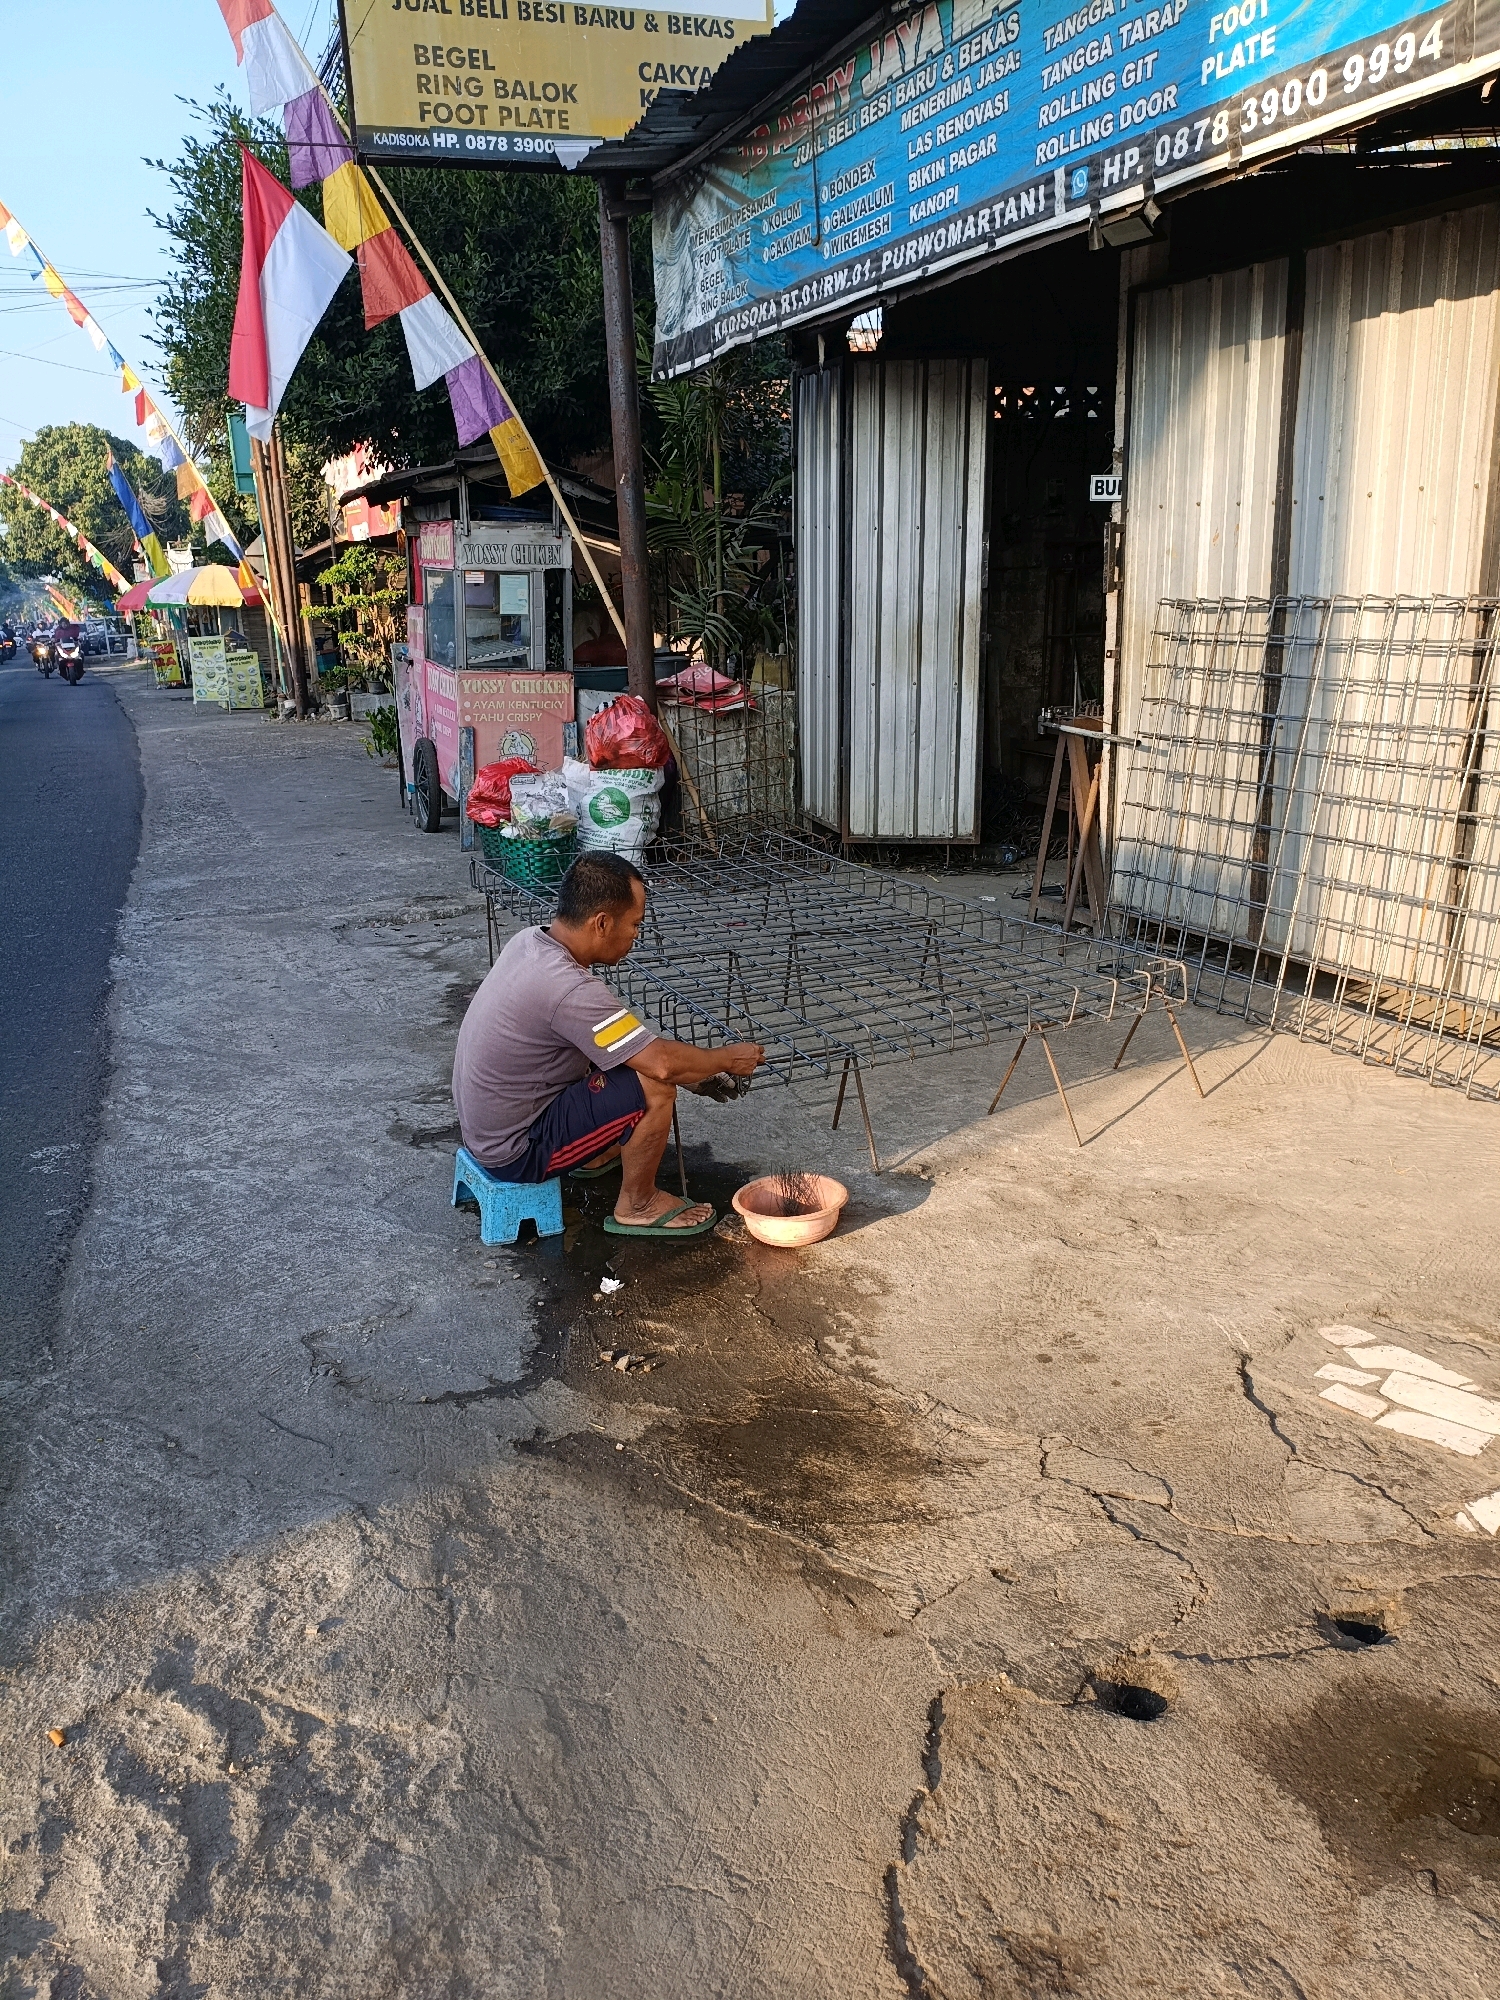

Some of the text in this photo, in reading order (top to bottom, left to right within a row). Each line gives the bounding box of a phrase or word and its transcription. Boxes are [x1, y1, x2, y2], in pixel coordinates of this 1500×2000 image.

[460, 0, 508, 19] BELI
[518, 1, 565, 23] BESI
[574, 6, 634, 30] BARU
[644, 13, 659, 32] &
[668, 15, 735, 39] BEKAS
[1043, 0, 1116, 53] TANGGA
[1209, 0, 1270, 43] FOOT
[414, 44, 495, 71] BEGEL
[861, 1, 945, 99] JAYA
[1041, 0, 1188, 91] TANGGA TARAP
[1201, 25, 1276, 86] PLATE
[417, 73, 578, 104] RING BALOK
[638, 62, 712, 86] CAKYA
[793, 140, 825, 169] JUAL
[828, 117, 857, 148] BELI
[860, 91, 892, 128] BESI
[896, 67, 937, 107] BARU
[941, 55, 955, 82] &
[958, 11, 1020, 72] BEKAS
[901, 51, 1021, 132] MENERIMA JASA:
[1038, 50, 1159, 129] ROLLING GIT
[419, 102, 569, 130] FOOT PLATE
[1102, 18, 1443, 188] HP. 0878 3900 9994
[373, 132, 554, 153] KADISOKA HP. 0878 3900
[908, 90, 1009, 160] LAS RENOVASI
[1035, 84, 1178, 166] ROLLING DOOR
[829, 158, 876, 200] BONDEX
[908, 132, 997, 192] BIKIN PAGAR
[691, 187, 777, 250] MENERIMA PESANAN
[769, 199, 801, 233] KOLOM
[831, 182, 894, 230] GALVALUM
[909, 184, 959, 224] KANOPI
[700, 227, 751, 270] FOOT PLATE
[769, 223, 812, 261] CAKYAM
[831, 213, 891, 257] WIREMESH
[701, 270, 724, 292] BEGEL
[714, 299, 776, 342] KADISOKA
[882, 186, 1045, 274] PURWOMARTANI
[701, 279, 749, 316] RING BALOK
[463, 544, 507, 564] YOSSY
[461, 679, 506, 694] YOSSY
[511, 679, 570, 694] CHICKEN
[473, 701, 565, 710] AYAM KENTUCKY
[473, 713, 542, 722] TAHU CRISPY
